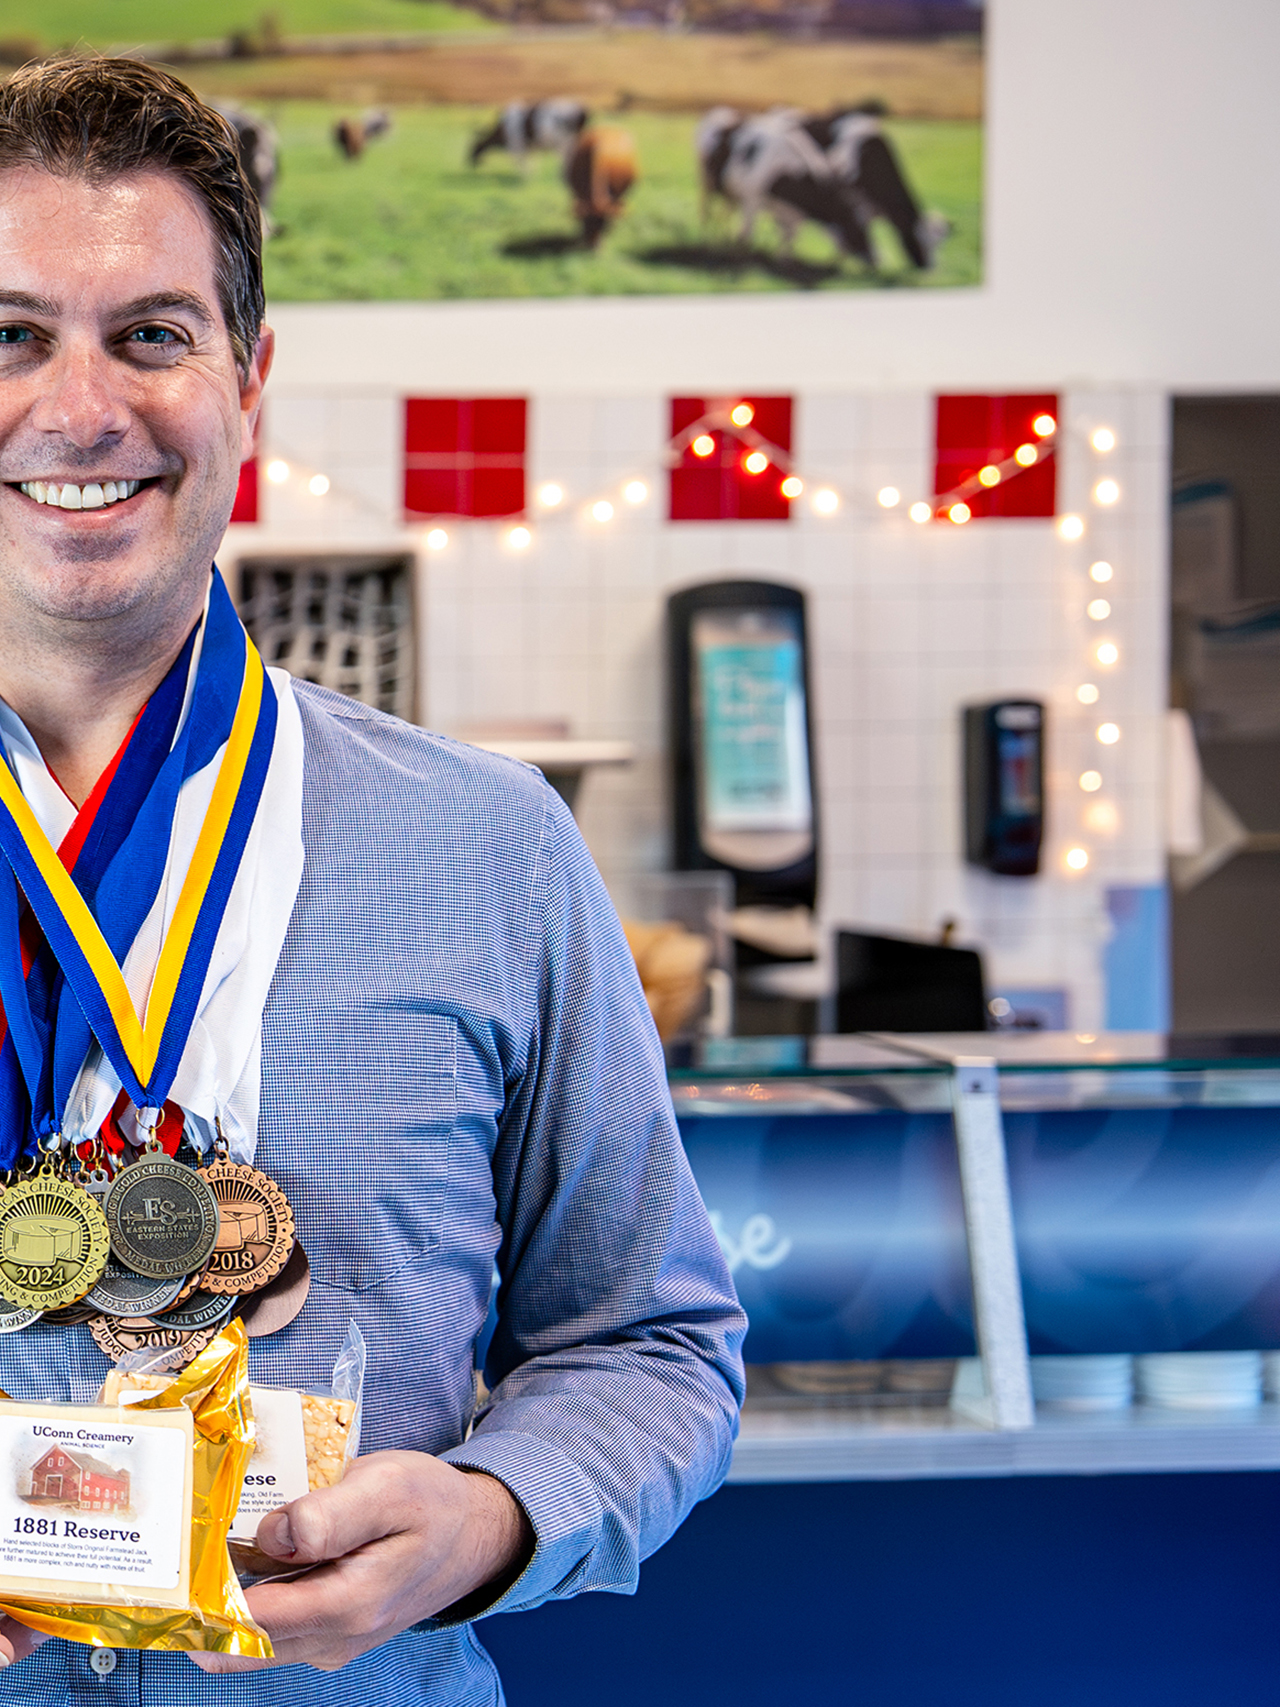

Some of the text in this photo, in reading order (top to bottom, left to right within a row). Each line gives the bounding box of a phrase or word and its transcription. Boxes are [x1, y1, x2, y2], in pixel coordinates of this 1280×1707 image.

[108, 1201, 118, 1220] BIG
[116, 1169, 141, 1193] GOLD
[141, 1164, 182, 1178] CHEESE
[207, 1168, 288, 1224] CHEESE SOCIETY
[29, 1182, 77, 1200] CHEESE
[76, 1195, 104, 1245] SOCIETY
[126, 1222, 199, 1234] EASTERN STATES
[138, 1231, 190, 1241] EXPOSITION
[125, 1250, 162, 1274] MEDAL
[209, 1251, 254, 1271] 2018
[224, 1237, 287, 1288] COMPETITION
[16, 1266, 65, 1286] 2024
[22, 1292, 30, 1300] &
[31, 1256, 98, 1302] COMPETITION
[91, 1287, 171, 1312] MEDAL WINNER
[135, 1330, 183, 1349] 2019
[32, 1425, 135, 1445] UConn Creamery
[243, 1474, 276, 1486] ese
[13, 1517, 141, 1543] 1881 Reserve
[84, 1544, 104, 1552] Original
[38, 1558, 62, 1566] complex,
[86, 1562, 98, 1570] nutty
